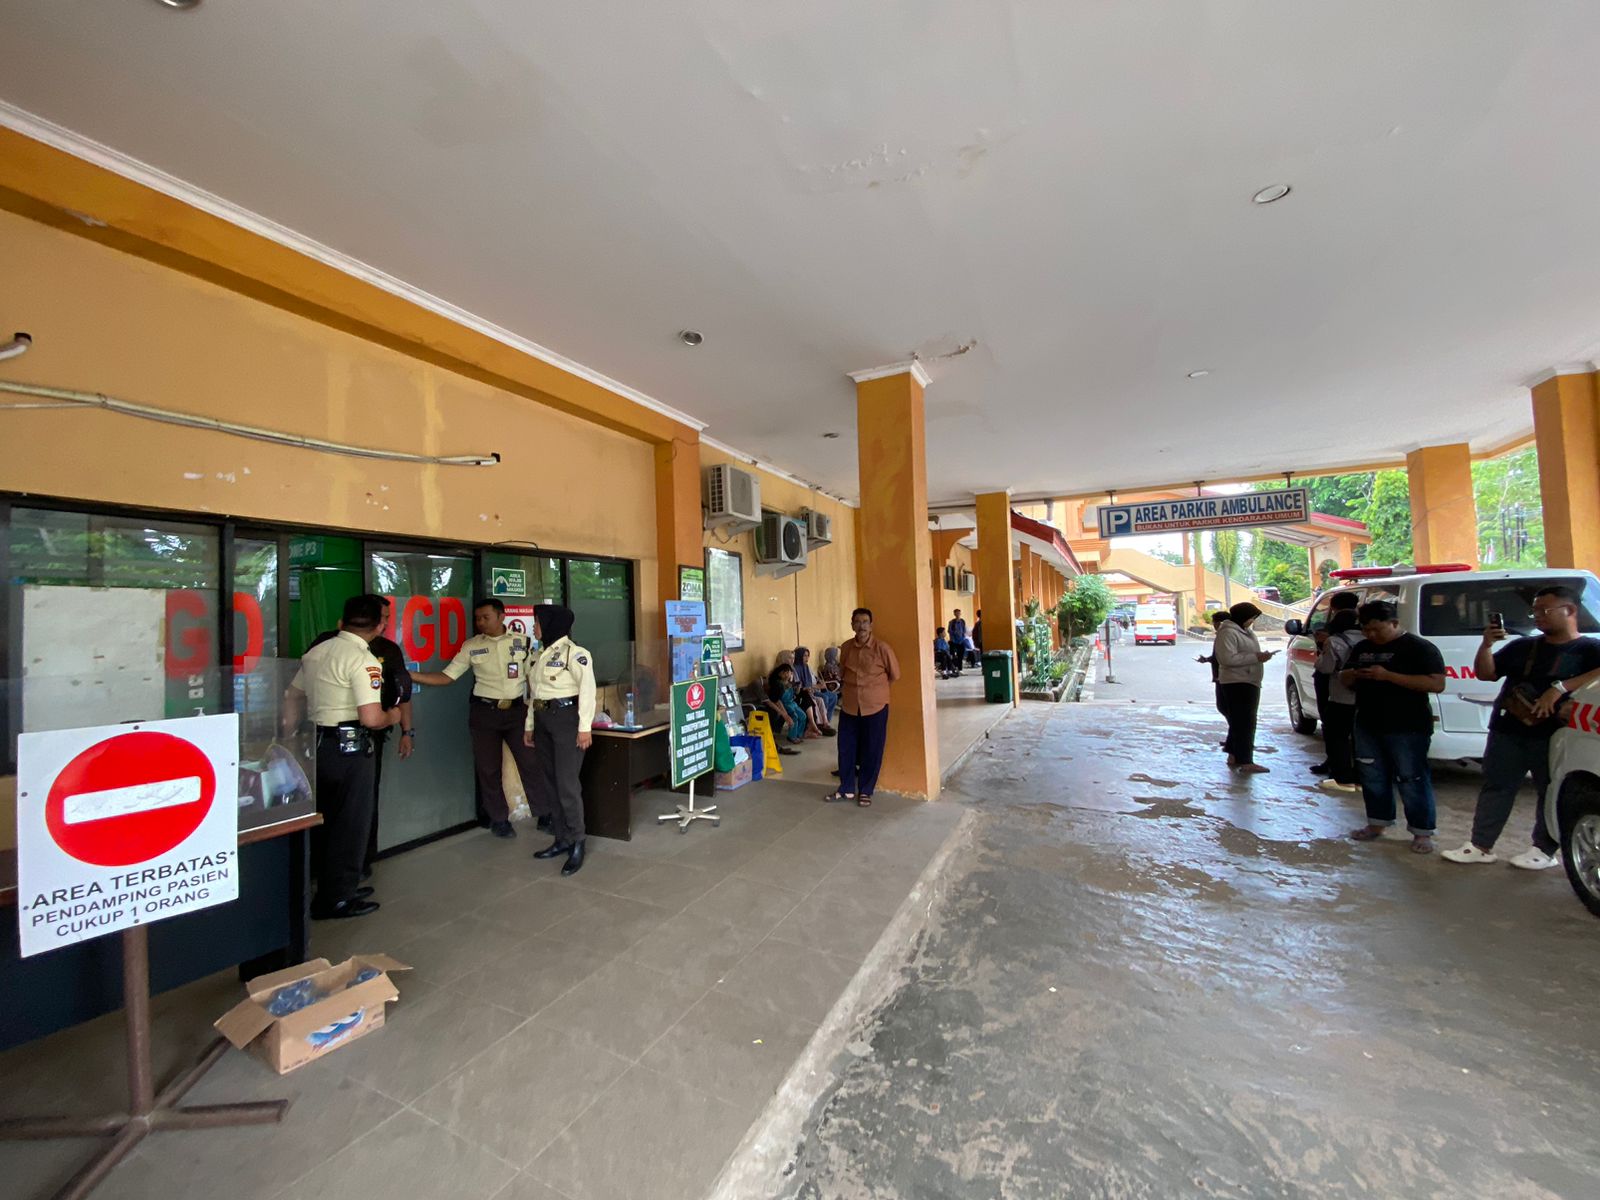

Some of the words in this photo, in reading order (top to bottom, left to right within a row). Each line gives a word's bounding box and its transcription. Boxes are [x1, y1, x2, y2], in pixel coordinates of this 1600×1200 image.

[1110, 510, 1128, 534] P
[1135, 507, 1166, 523] AREA
[1171, 501, 1216, 519] PARKIR
[1221, 493, 1302, 515] AMBULANCE
[1137, 523, 1163, 531] BUKAN
[1163, 520, 1191, 529] UNTUK
[1192, 518, 1221, 527] PARKIR
[1221, 514, 1274, 525] KENDARAAN
[1274, 511, 1301, 520] UMUM
[383, 594, 467, 663] IGD
[1444, 666, 1477, 679] AM
[32, 881, 103, 910] AREA
[110, 852, 228, 891] TERBATAS
[32, 887, 162, 927] PENDAMPING
[168, 867, 229, 893] PASIEN
[56, 911, 125, 937] CUKUP
[131, 906, 138, 917] 1
[145, 888, 210, 913] ORANG
